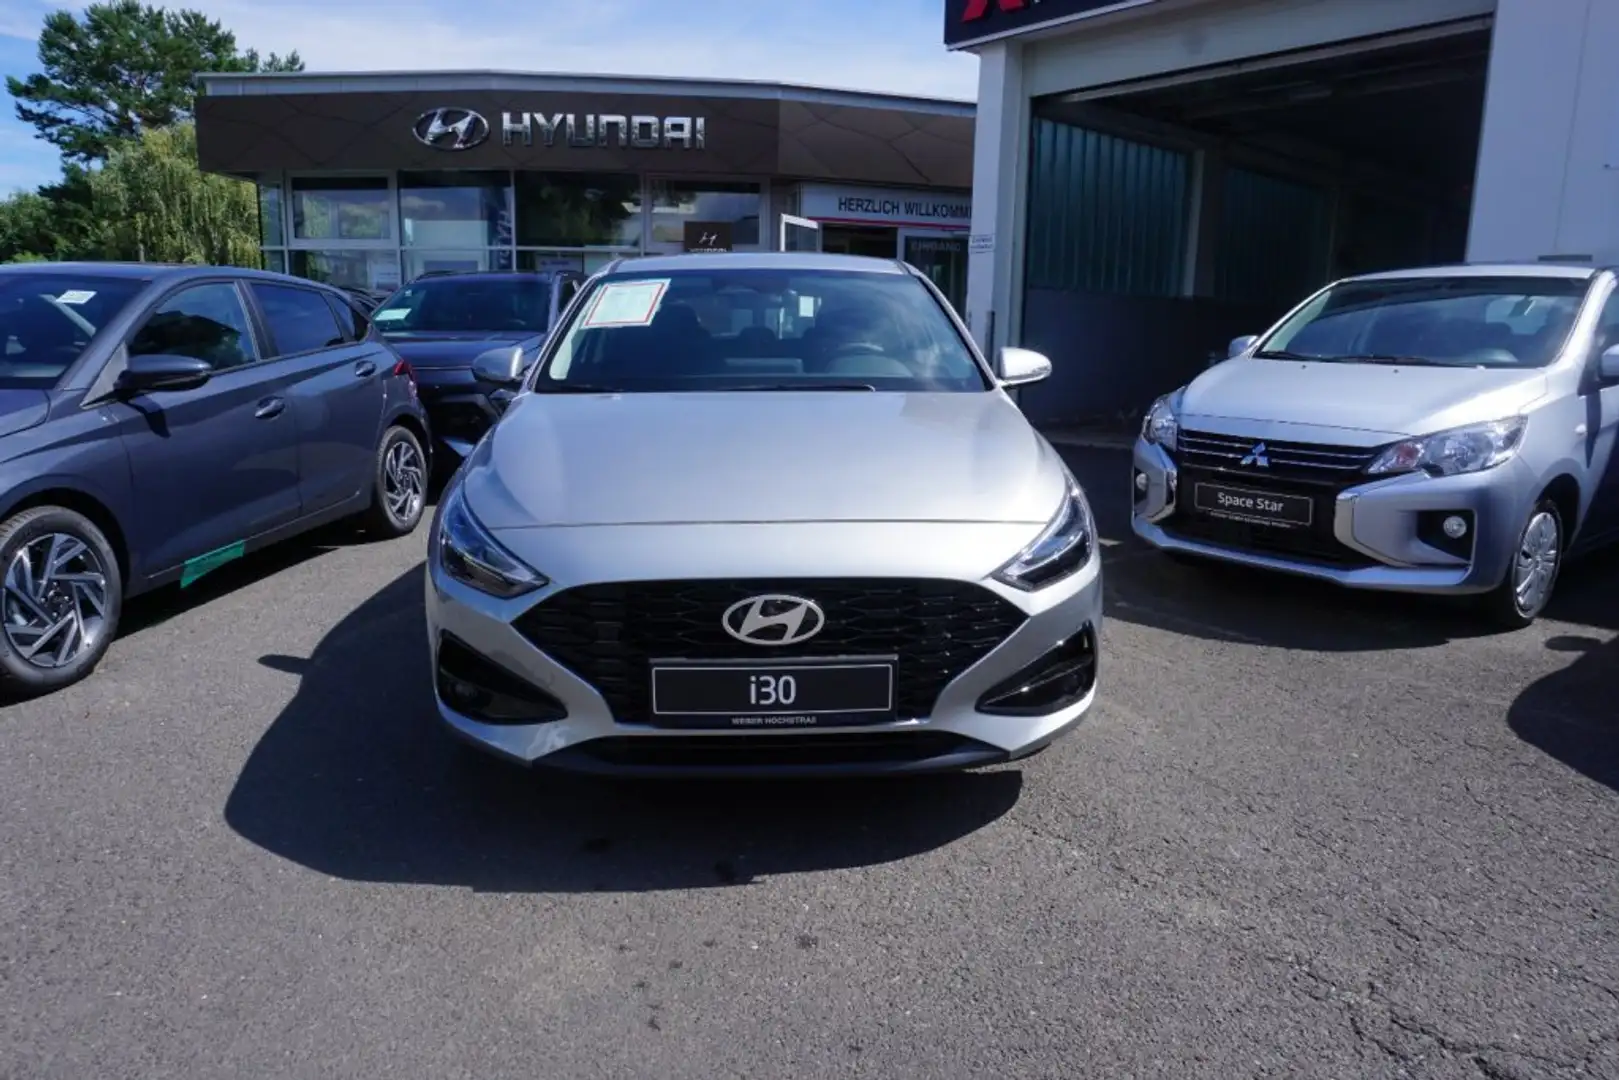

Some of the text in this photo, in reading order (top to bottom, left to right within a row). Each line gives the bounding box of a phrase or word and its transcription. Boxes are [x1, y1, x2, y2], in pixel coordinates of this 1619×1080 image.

[501, 111, 706, 149] HYUNDAI
[838, 196, 971, 218] HERZLICH WILLKOMM
[1217, 492, 1284, 512] Space Star
[749, 675, 797, 705] i30
